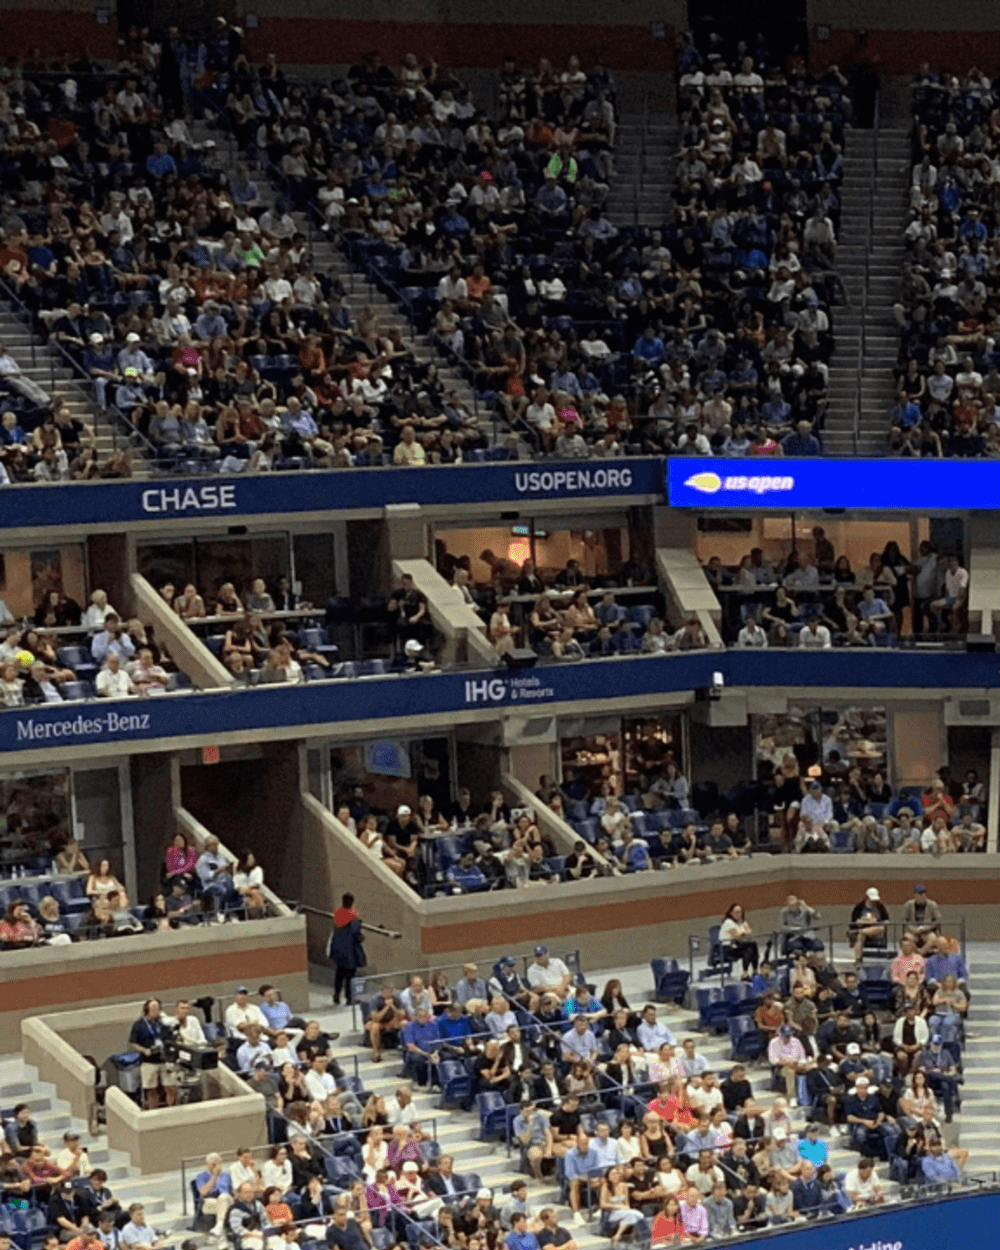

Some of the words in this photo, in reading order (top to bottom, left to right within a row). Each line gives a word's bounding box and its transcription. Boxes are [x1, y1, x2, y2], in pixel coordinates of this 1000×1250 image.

[515, 469, 632, 492] USOPEN.ORG
[142, 485, 237, 513] CHASE
[465, 679, 506, 702] IHG
[16, 712, 151, 741] Mercedes-Benz
